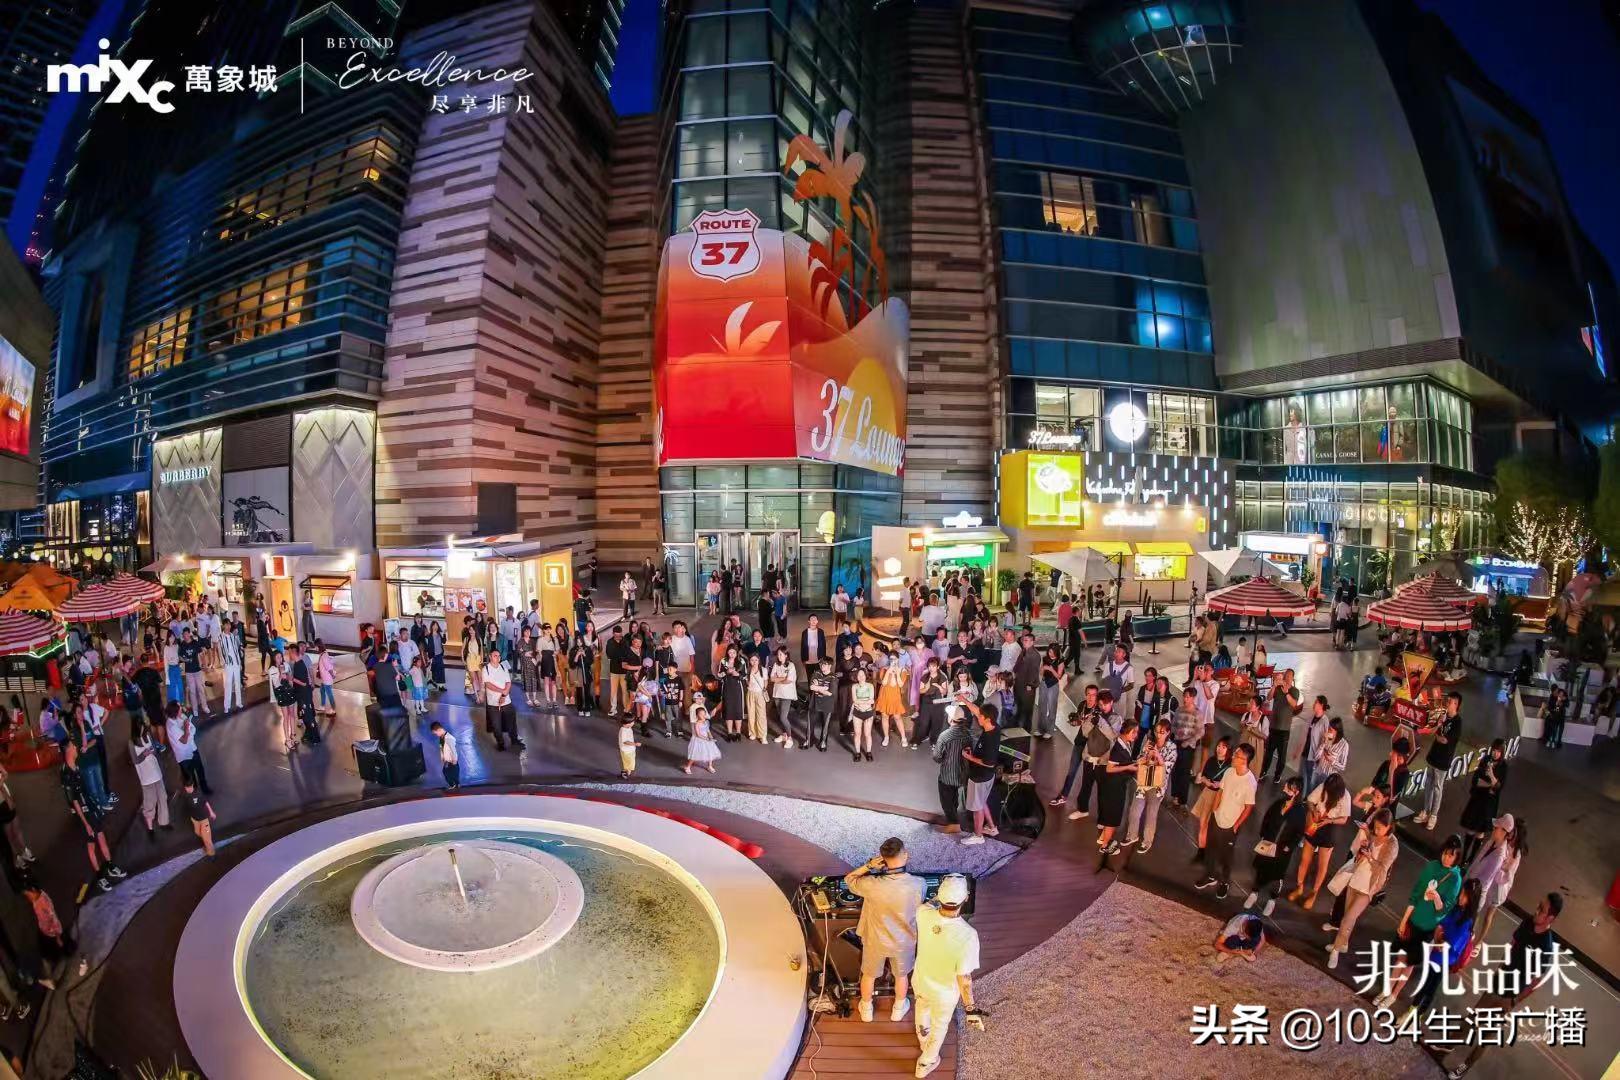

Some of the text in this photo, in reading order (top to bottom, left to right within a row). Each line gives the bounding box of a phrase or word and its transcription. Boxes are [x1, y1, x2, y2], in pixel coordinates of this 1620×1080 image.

[700, 219, 752, 230] ROUTE
[701, 241, 750, 266] 37
[811, 379, 906, 470] 37 Lounge
[160, 466, 212, 484] BURBERRY
